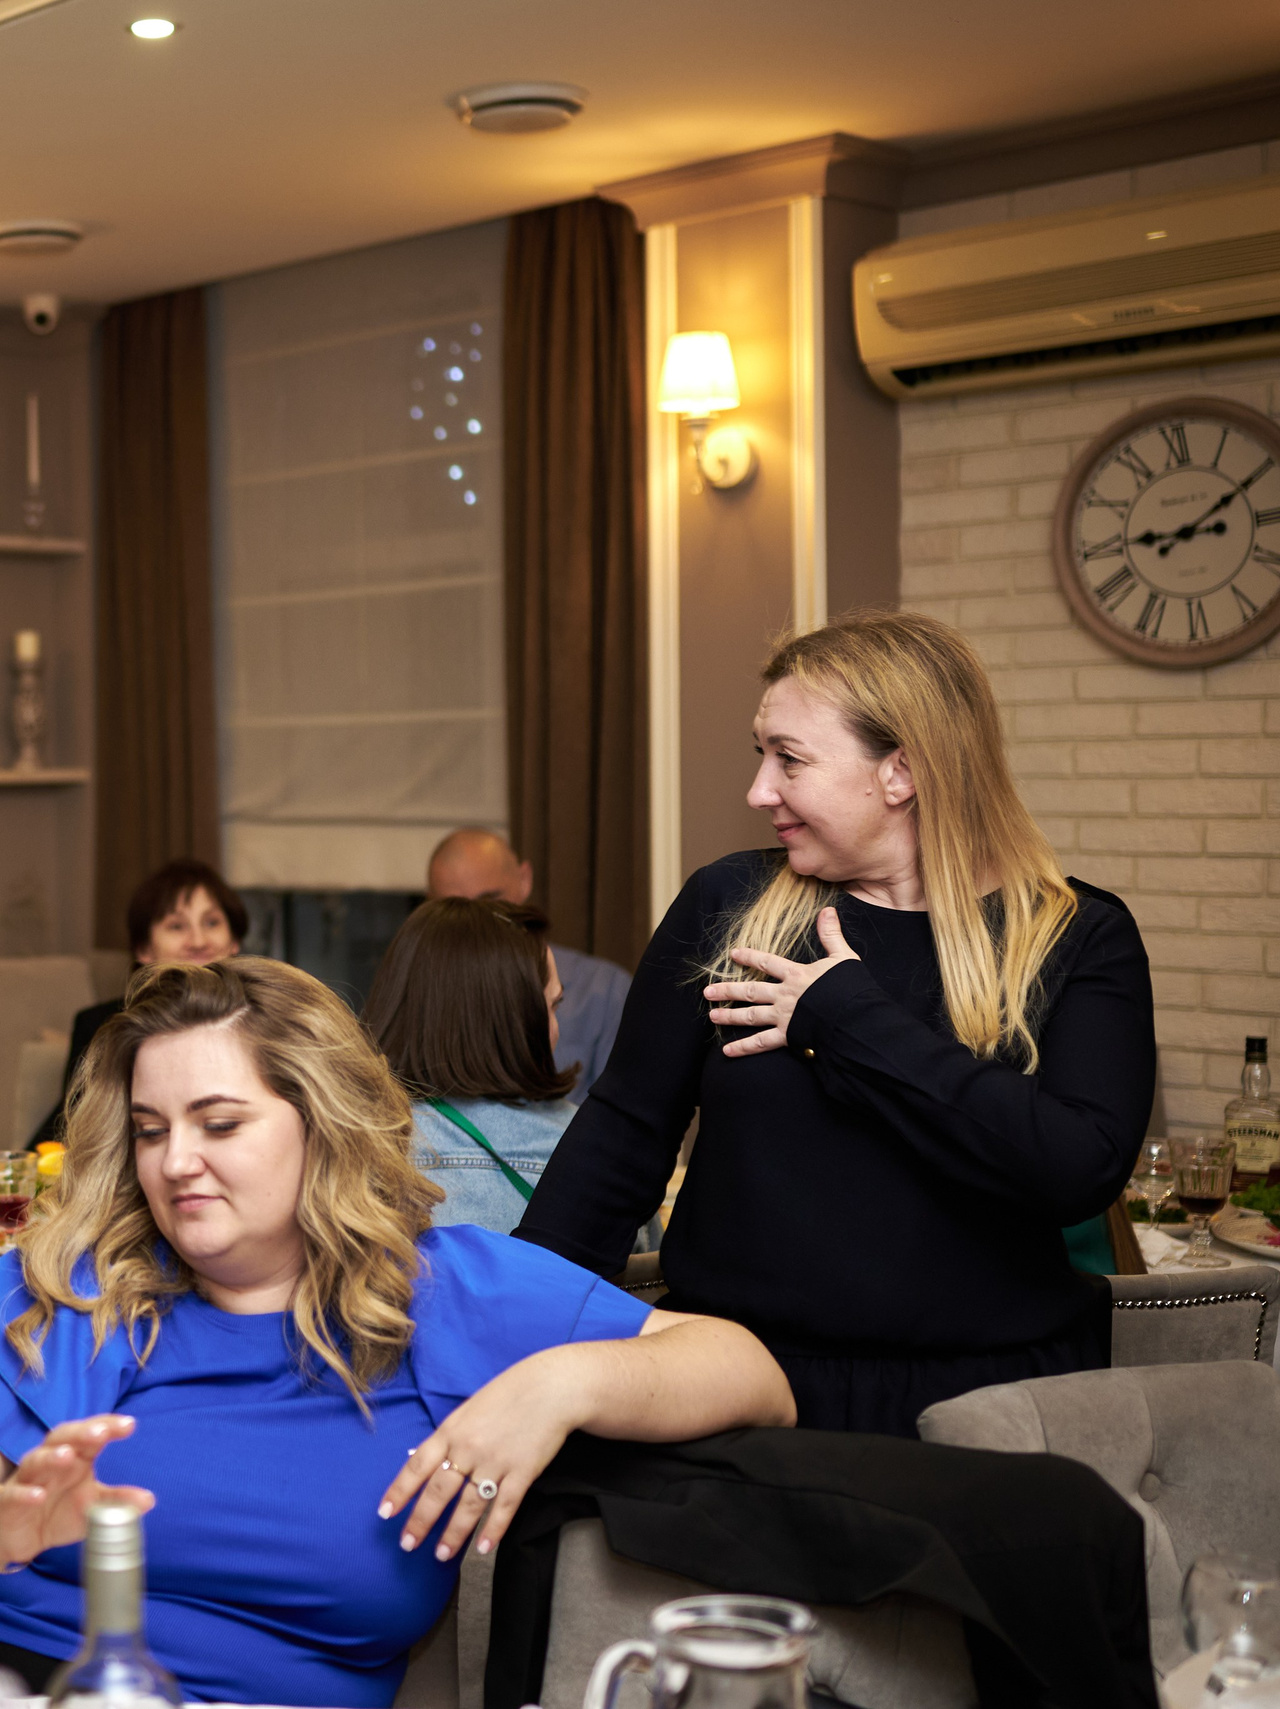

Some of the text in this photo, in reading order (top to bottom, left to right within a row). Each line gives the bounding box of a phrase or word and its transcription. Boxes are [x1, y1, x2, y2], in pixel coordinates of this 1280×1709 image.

[1115, 444, 1155, 490] XI
[1159, 423, 1192, 470] XII
[1211, 427, 1230, 469] I
[1088, 488, 1130, 519] X
[1094, 565, 1140, 613] VIII
[1230, 582, 1259, 622] V
[1135, 591, 1167, 639] VII
[1186, 598, 1211, 641] VI
[1227, 1127, 1280, 1141] STEERSMAN
